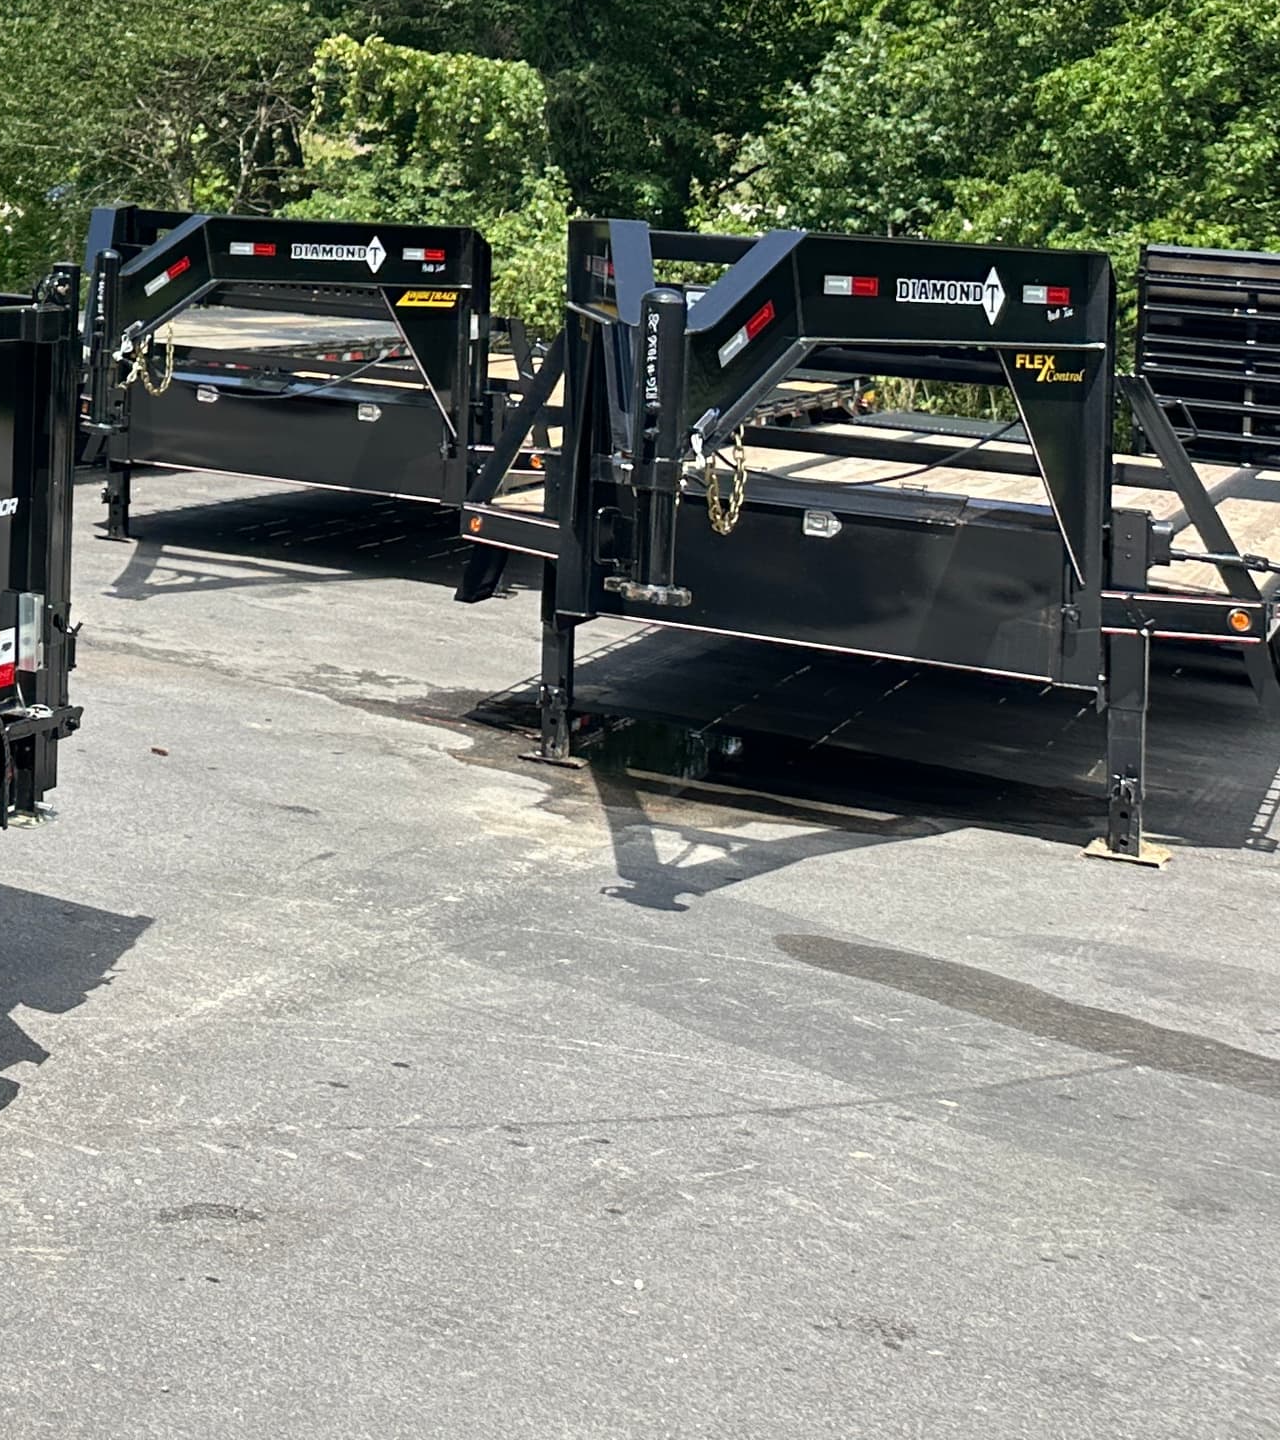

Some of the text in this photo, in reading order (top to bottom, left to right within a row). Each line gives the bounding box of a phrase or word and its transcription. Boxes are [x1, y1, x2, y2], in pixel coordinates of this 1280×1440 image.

[292, 244, 368, 260] DIAMOND
[897, 280, 984, 303] DIAMOND
[1016, 353, 1056, 382] FLEX
